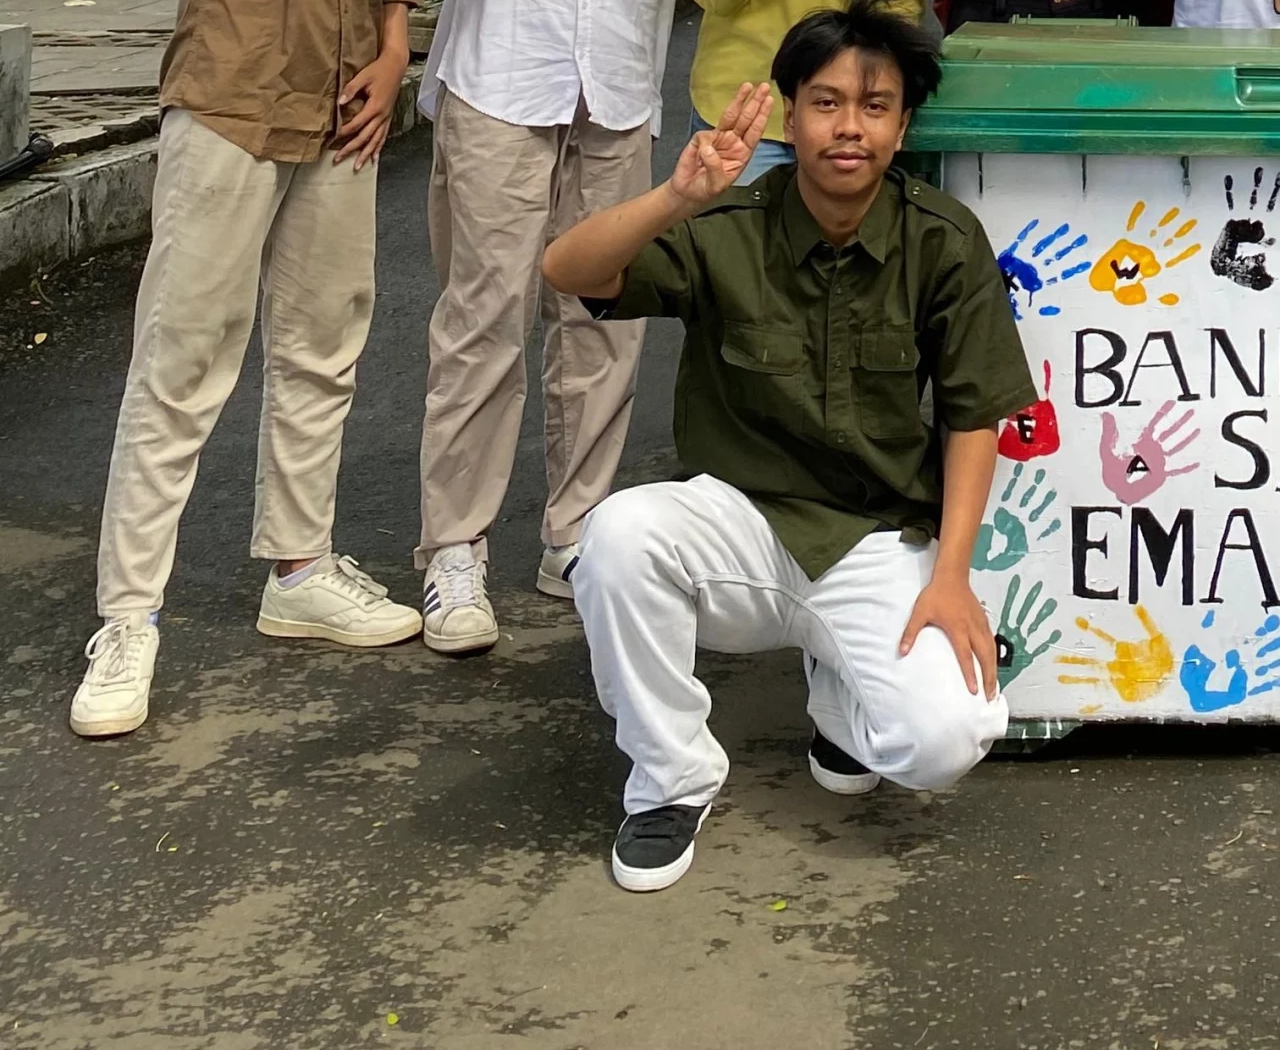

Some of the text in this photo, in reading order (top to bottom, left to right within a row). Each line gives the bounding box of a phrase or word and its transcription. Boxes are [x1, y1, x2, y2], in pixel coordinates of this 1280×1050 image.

[1110, 260, 1140, 279] W
[1016, 414, 1035, 443] E
[1126, 454, 1149, 474] A
